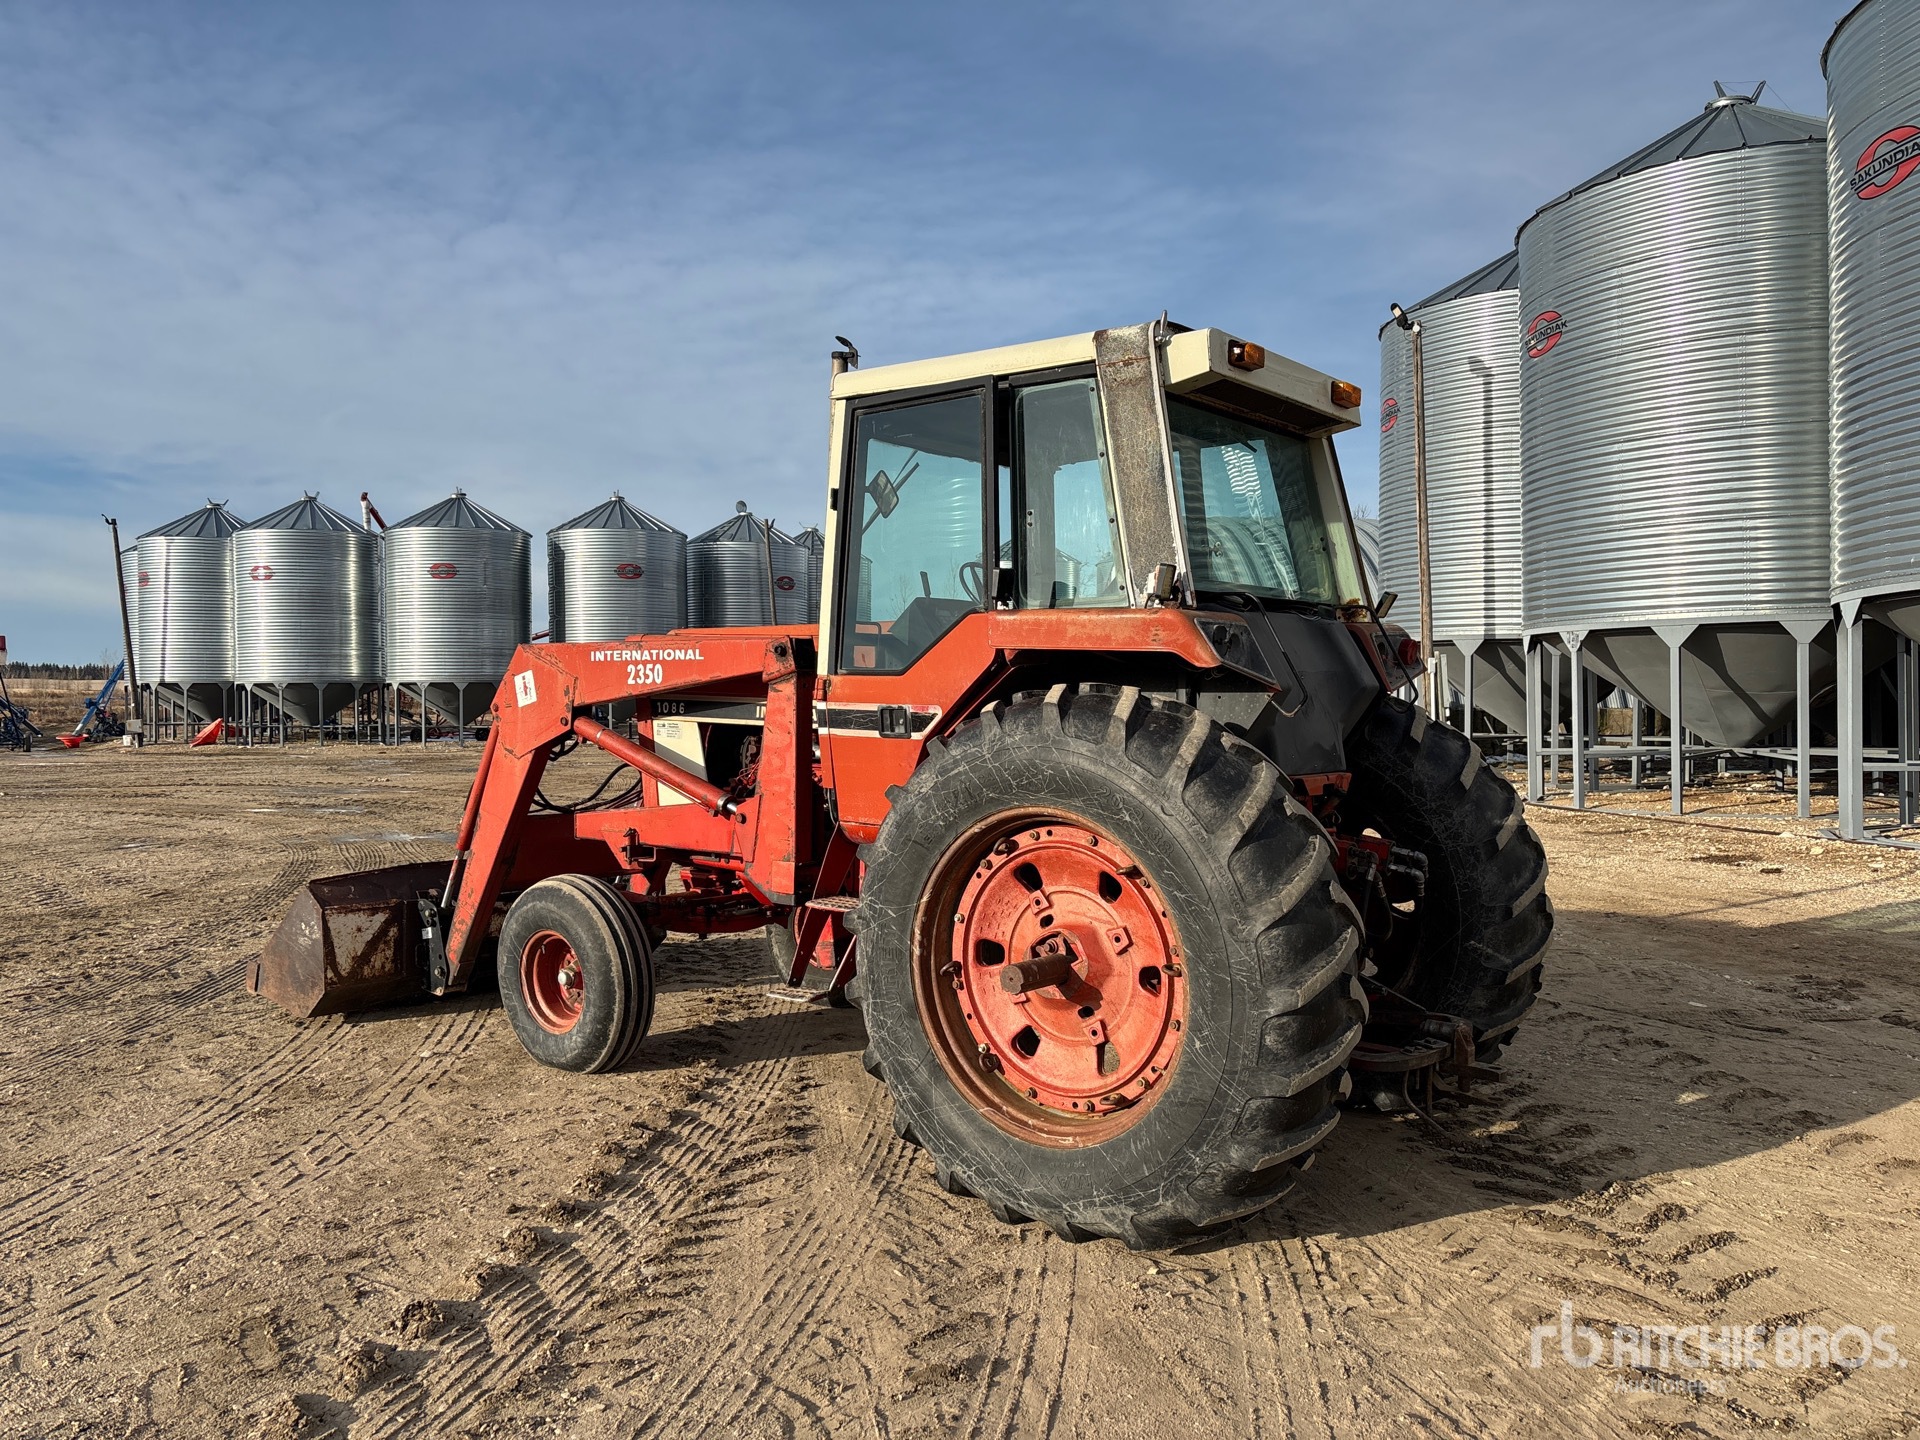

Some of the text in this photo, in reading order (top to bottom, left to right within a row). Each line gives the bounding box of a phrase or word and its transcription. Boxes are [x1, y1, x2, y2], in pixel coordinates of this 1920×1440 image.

[1849, 141, 1920, 190] SAKUNDIA
[590, 648, 705, 662] INTERNATIONAL
[627, 663, 663, 685] 2350
[657, 701, 685, 714] 1086
